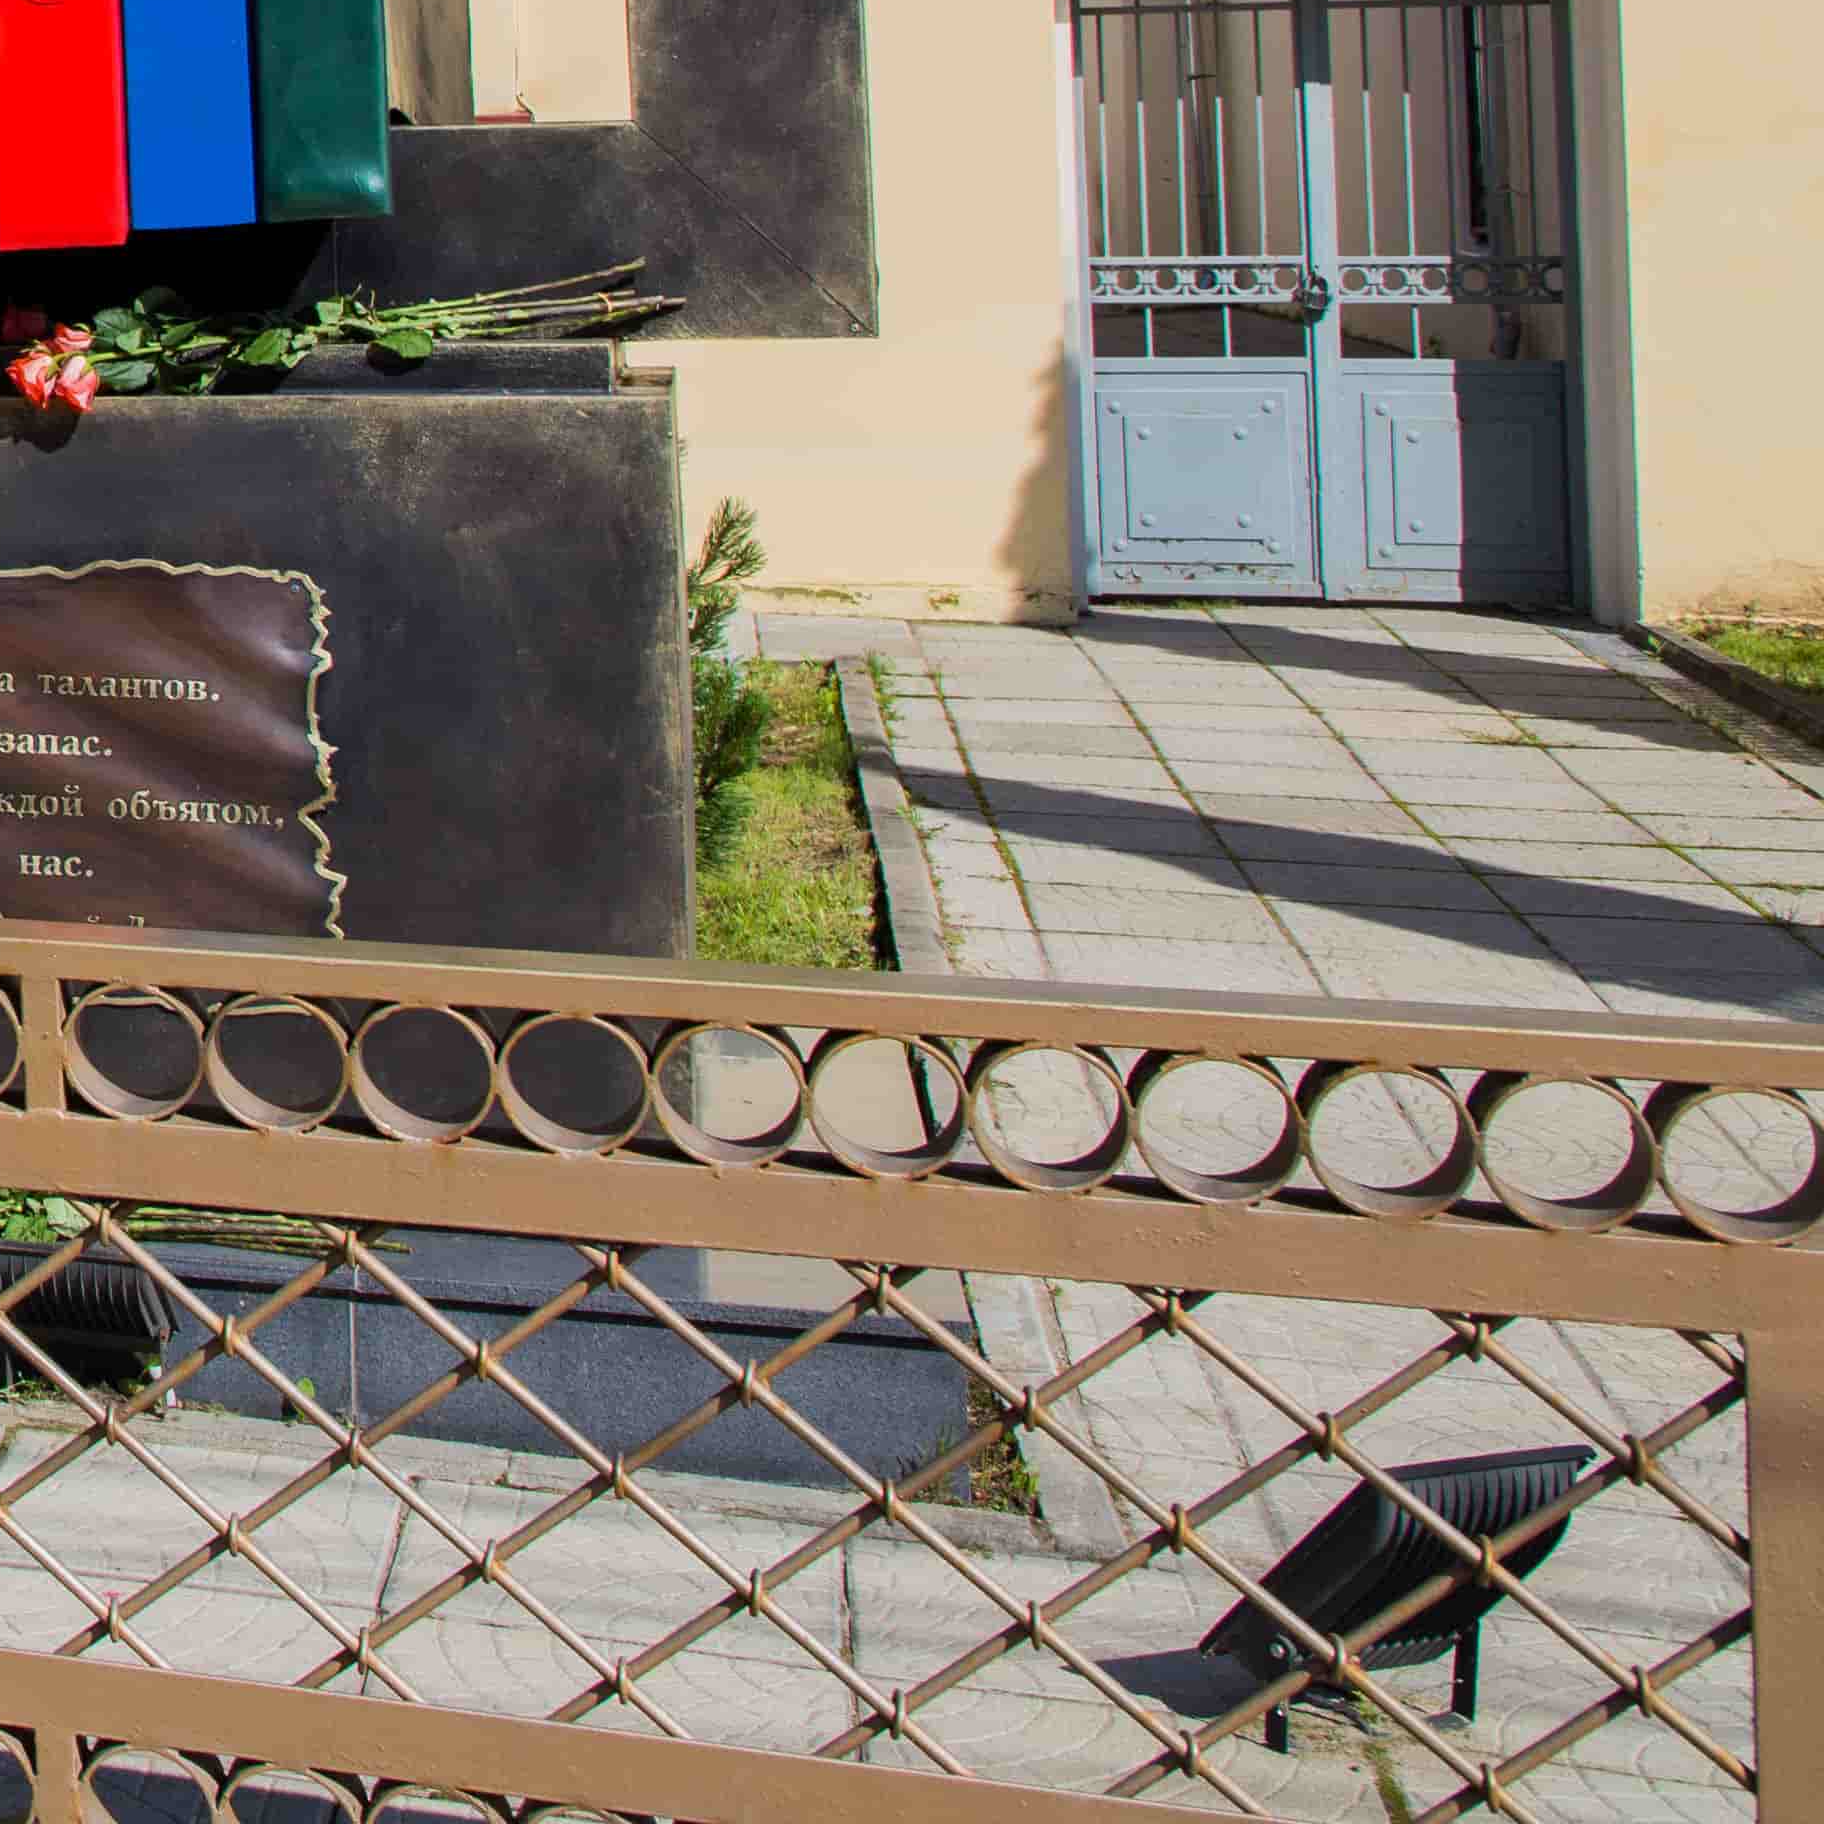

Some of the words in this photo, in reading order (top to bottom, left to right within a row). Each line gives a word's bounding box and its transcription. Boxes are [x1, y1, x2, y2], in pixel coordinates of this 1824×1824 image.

[37, 669, 222, 703] талантов.
[106, 792, 286, 832] объятом,
[17, 849, 95, 879] нас.
